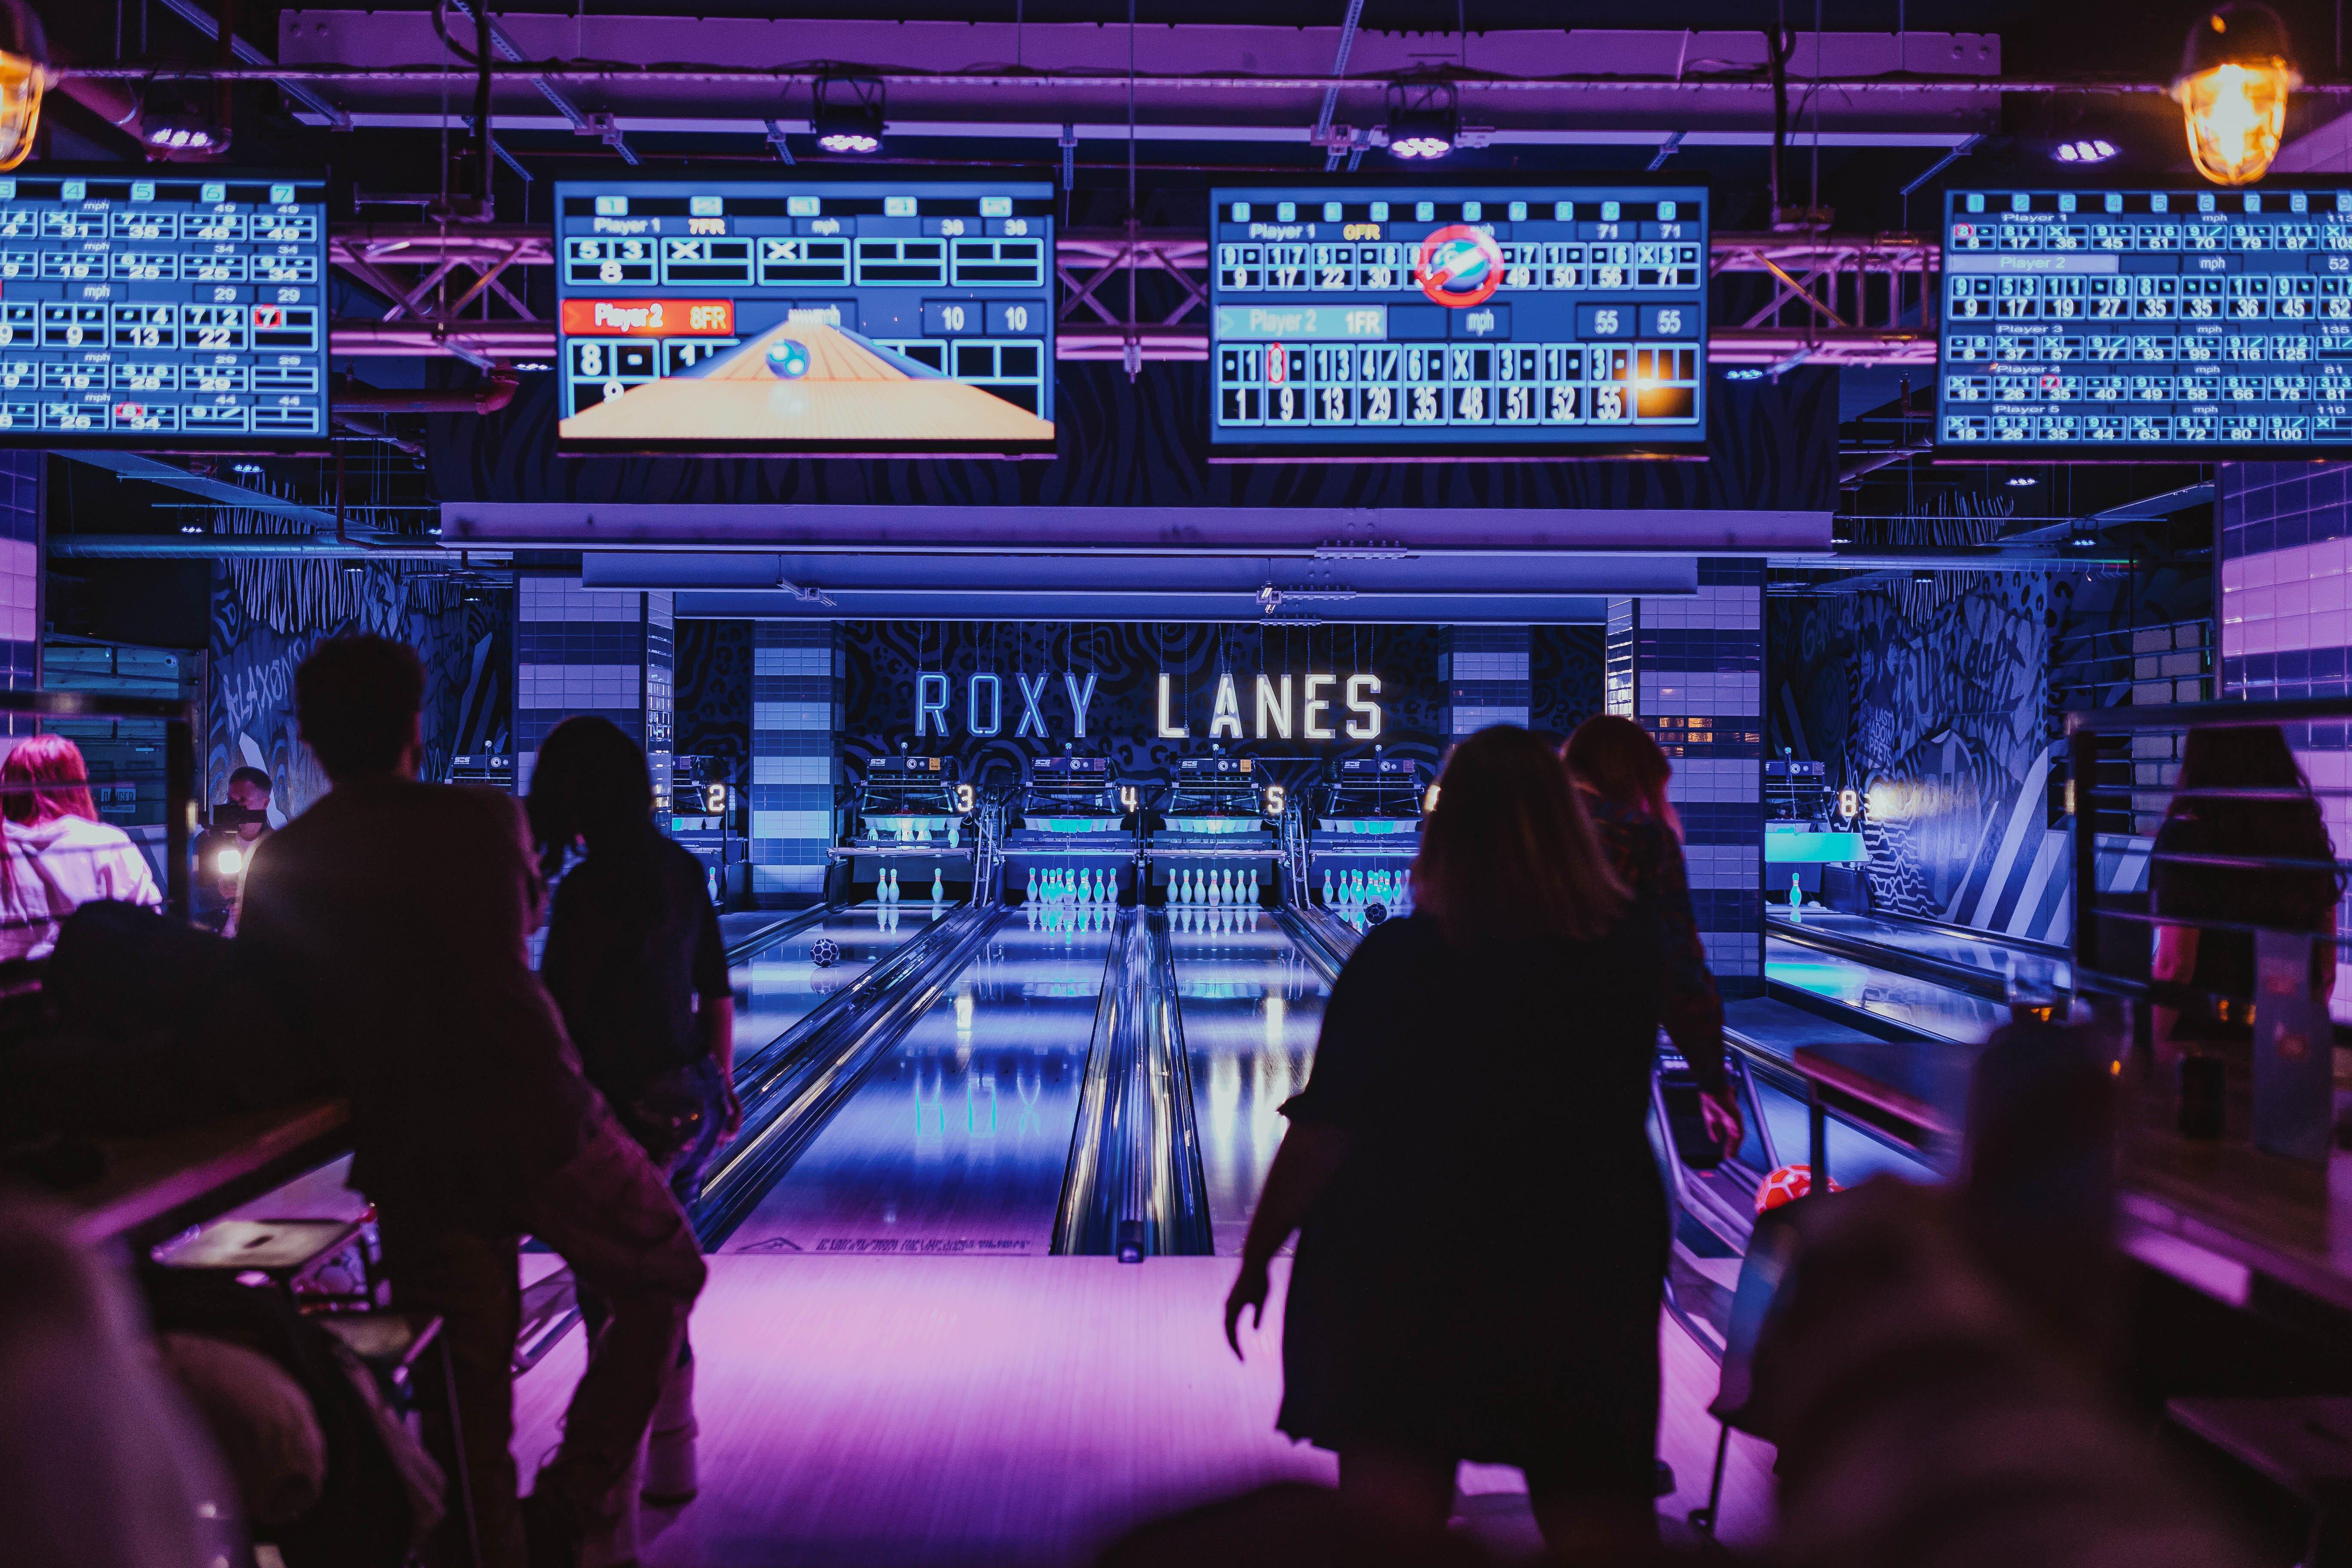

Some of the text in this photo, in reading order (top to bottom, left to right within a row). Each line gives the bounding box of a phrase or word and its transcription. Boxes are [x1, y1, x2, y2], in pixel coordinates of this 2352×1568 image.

[85, 201, 110, 212] mph
[595, 217, 648, 236] Player
[651, 218, 660, 233] 1
[2003, 214, 2054, 223] Player
[2202, 214, 2227, 222] mph
[62, 225, 299, 241] 31 38 46 49
[1250, 224, 1302, 241] Player
[1307, 224, 1315, 238] 1
[1598, 224, 1617, 239] 71
[1661, 224, 1681, 239] 71
[579, 240, 600, 260] 5
[623, 240, 643, 260] 3
[60, 264, 299, 281] 19 25 25 34
[600, 260, 622, 284] 8
[2001, 257, 2349, 271] Player 2 mph 52
[1234, 266, 1678, 288] 9 17 22 30 49 50 56 71
[84, 285, 300, 302] mph 29 29
[153, 308, 275, 327] 4 7 2 7
[594, 303, 1027, 332] Player 2 8FR 10 10
[1965, 299, 2351, 317] 9 17 19 27 35 35 36 45 52
[1250, 309, 1302, 336] Player
[1305, 309, 1317, 331] 2
[1468, 309, 1494, 335] mph
[1596, 310, 1618, 333] 55
[1658, 310, 1681, 333] 55
[1998, 325, 2049, 336] Player
[2197, 326, 2222, 334] mph
[66, 325, 231, 349] 9 13 22
[581, 344, 602, 376] 8
[1246, 350, 1256, 381] 1
[1271, 348, 1283, 381] 8
[1362, 350, 1375, 380] 4
[1409, 349, 1421, 381] 6
[1501, 349, 1513, 380] 3
[1548, 349, 1558, 380] 1
[1593, 349, 1605, 380] 3
[1997, 366, 2047, 374] Player
[2196, 366, 2220, 374] mph
[61, 374, 90, 388] 19
[1236, 386, 1621, 421] 1 9 13 29 35 48 51 52 55
[1995, 406, 2045, 414] Player
[2193, 406, 2218, 414] mph
[60, 416, 161, 430] 26 34
[915, 672, 1381, 740] ROXY LANES
[709, 784, 726, 812] 2
[958, 784, 972, 812] 3
[1121, 787, 1136, 812] 4
[1267, 787, 1283, 813] 5
[1841, 790, 1856, 817] 8
